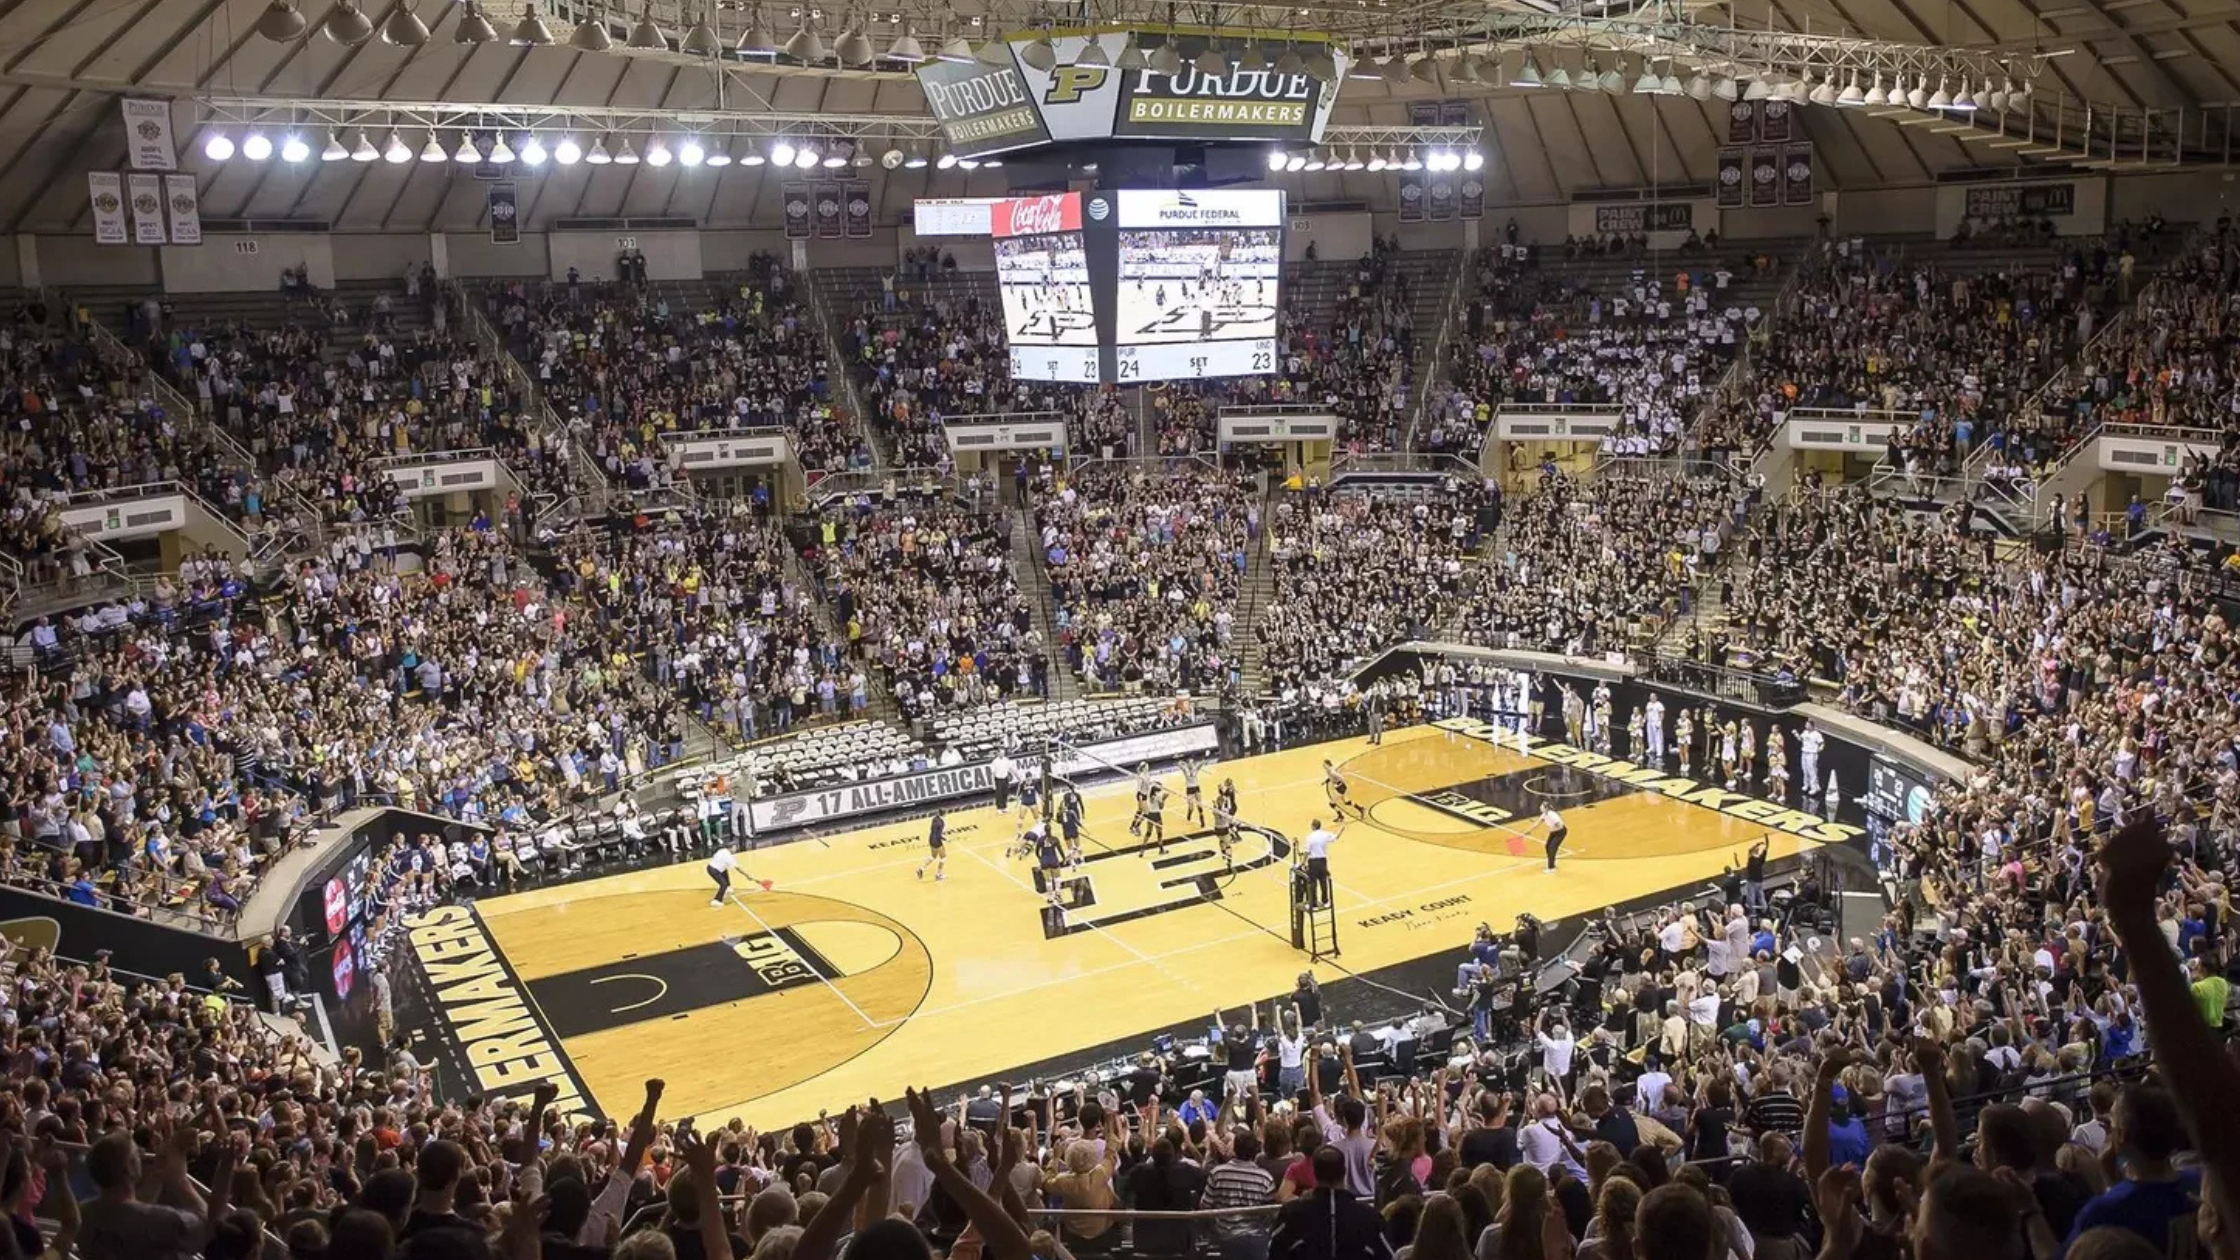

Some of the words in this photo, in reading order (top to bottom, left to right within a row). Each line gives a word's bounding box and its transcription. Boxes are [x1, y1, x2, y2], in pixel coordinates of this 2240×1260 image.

[926, 68, 1025, 119] PURDUE
[1135, 102, 1303, 121] BOILERMAKERS
[951, 109, 1035, 141] BOILERMAKERS
[1969, 189, 2023, 203] PAINT
[1159, 210, 1199, 219] PURDUE
[1200, 210, 1241, 219] FEDERAL
[1599, 207, 1646, 220] PAINT
[1968, 203, 2020, 215] CREW
[1599, 218, 1643, 230] CREW
[236, 242, 257, 253] 118
[1084, 360, 1097, 379] 23
[1119, 359, 1140, 378] 24
[1189, 356, 1208, 368] SET
[1252, 353, 1272, 371] 23
[1431, 717, 1866, 842] BOILERMAKERS
[817, 792, 842, 815] 17
[1357, 909, 1415, 928] KEADY
[1420, 894, 1472, 911] COURT
